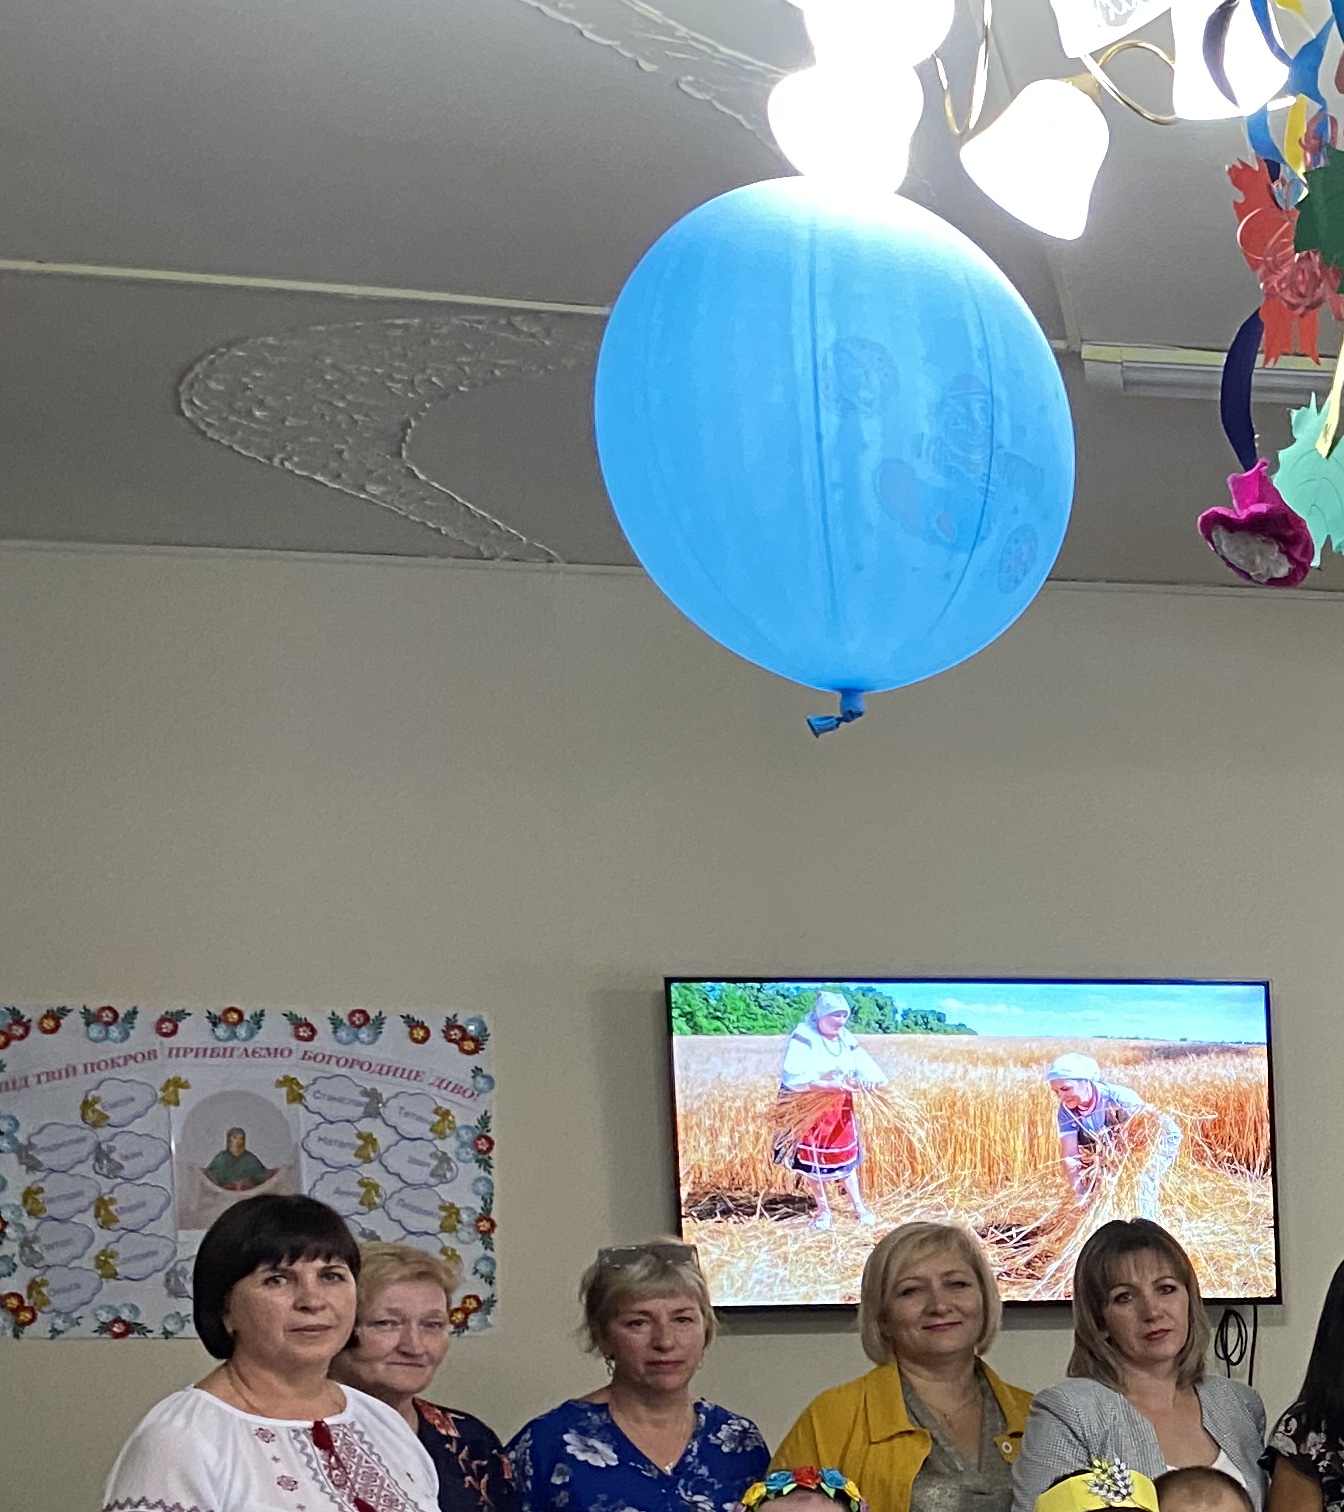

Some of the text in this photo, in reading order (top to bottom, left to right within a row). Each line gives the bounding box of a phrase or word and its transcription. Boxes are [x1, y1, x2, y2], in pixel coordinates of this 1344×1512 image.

[32, 1064, 77, 1086] ТВІЙ
[83, 1048, 158, 1075] ПОКРОВ
[300, 1049, 426, 1083] БОГОРОДИЦЕ
[428, 1076, 482, 1102] ДІВО!
